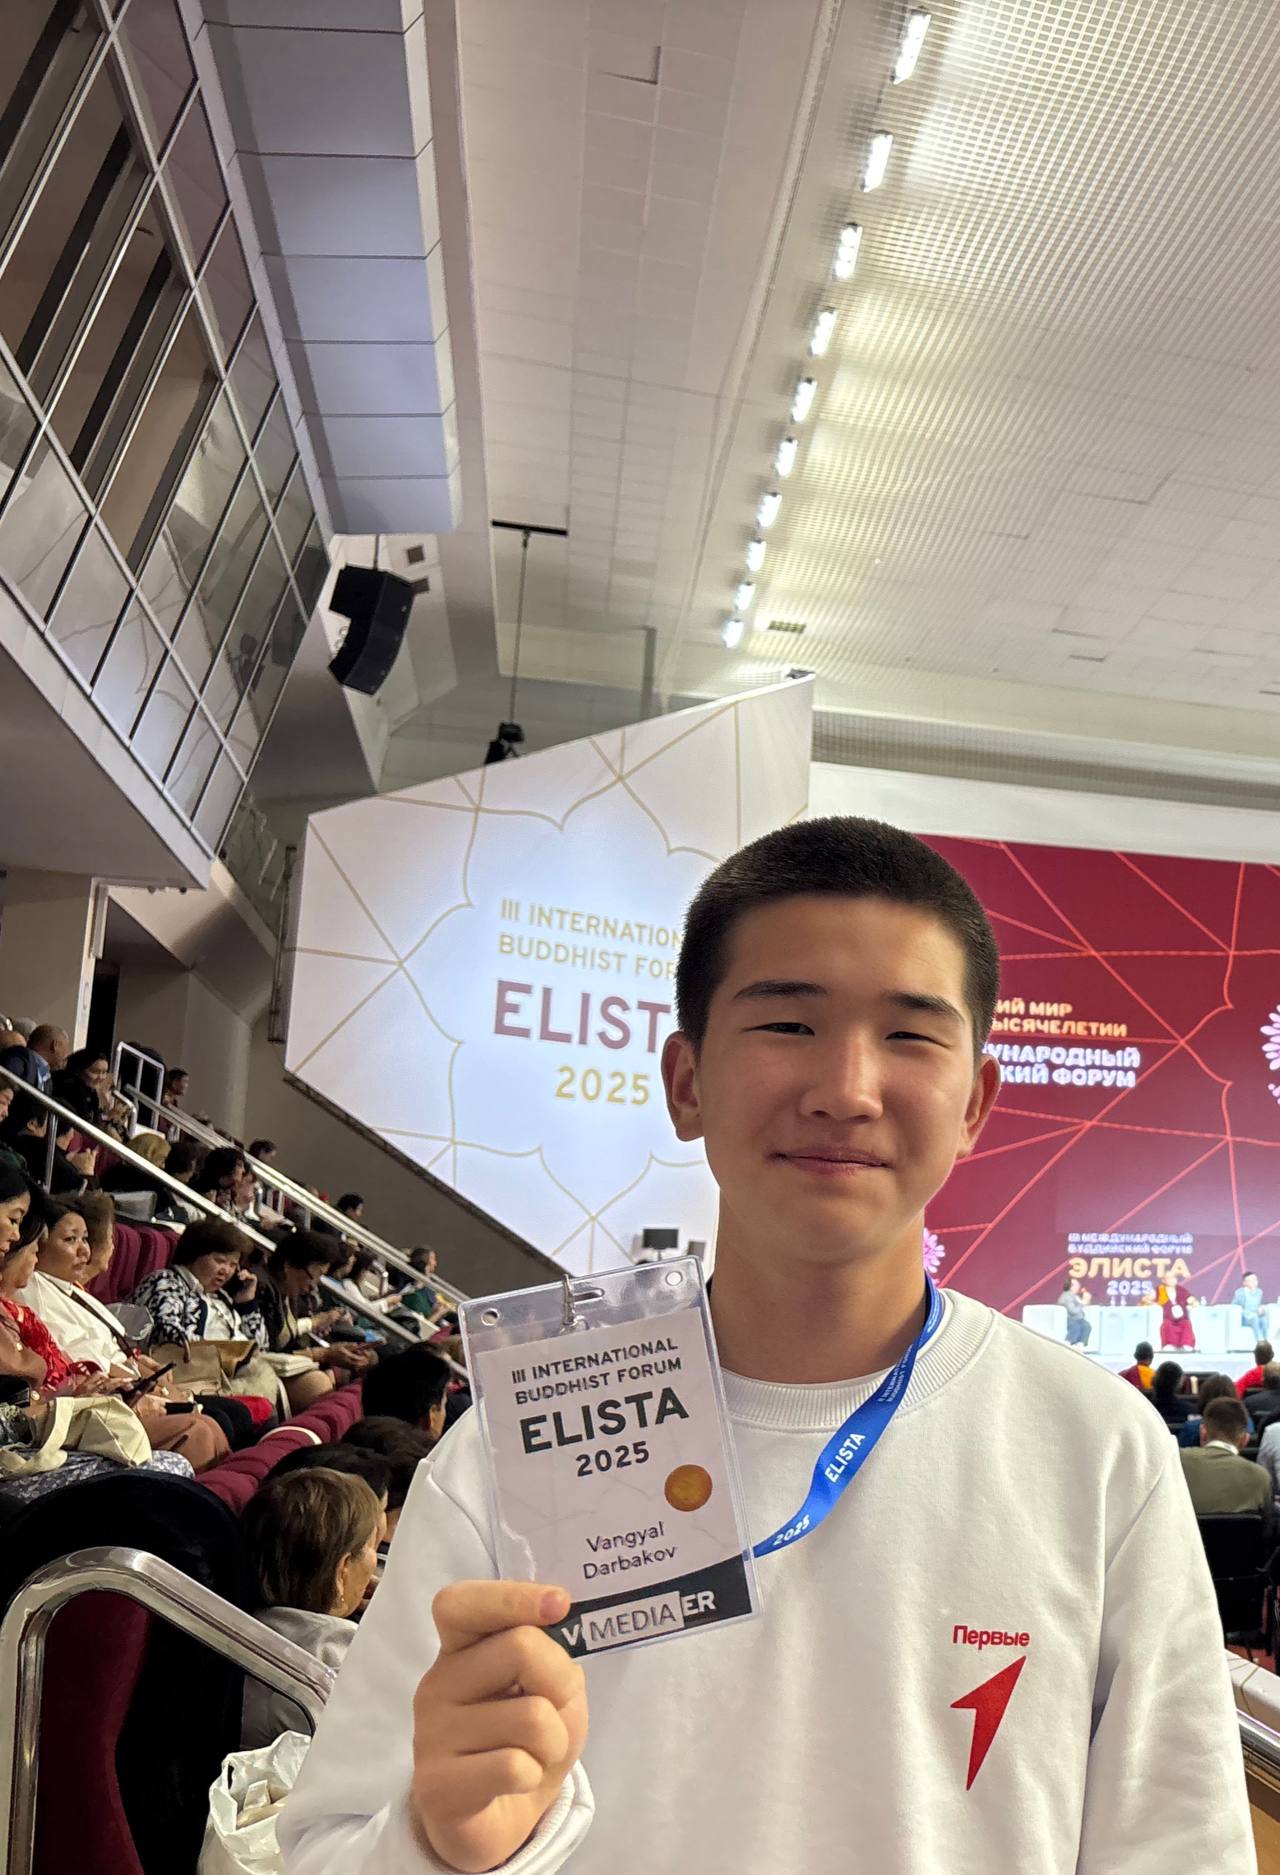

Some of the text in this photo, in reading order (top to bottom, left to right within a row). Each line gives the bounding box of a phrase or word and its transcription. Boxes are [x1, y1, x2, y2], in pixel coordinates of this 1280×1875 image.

[501, 898, 684, 949] III INTERNATION
[498, 933, 677, 981] BUDDHIST FOR
[494, 979, 672, 1053] ELIST
[1029, 1001, 1073, 1017] МИР
[991, 1017, 1128, 1037] ЫСЯЧЕЛЕТИИ
[983, 1043, 1141, 1068] УНАРОДНЫЙ
[555, 1064, 650, 1106] 2025
[1052, 1067, 1136, 1088] ФОРУМ
[1068, 1257, 1191, 1279] ЭЛИСТА
[1107, 1280, 1153, 1295] 2025
[511, 1337, 678, 1384] III INTERNATIONAL
[515, 1357, 682, 1404] BUDDHIST FORUM
[520, 1386, 690, 1454] ELISTA
[576, 1440, 650, 1477] 2025
[824, 1433, 866, 1483] ELISTA
[586, 1521, 664, 1552] Vangyal
[773, 1515, 811, 1546] 2025
[583, 1546, 678, 1579] Darbakov
[589, 1603, 677, 1641] MEDIA
[952, 1625, 1030, 1651] Первые
